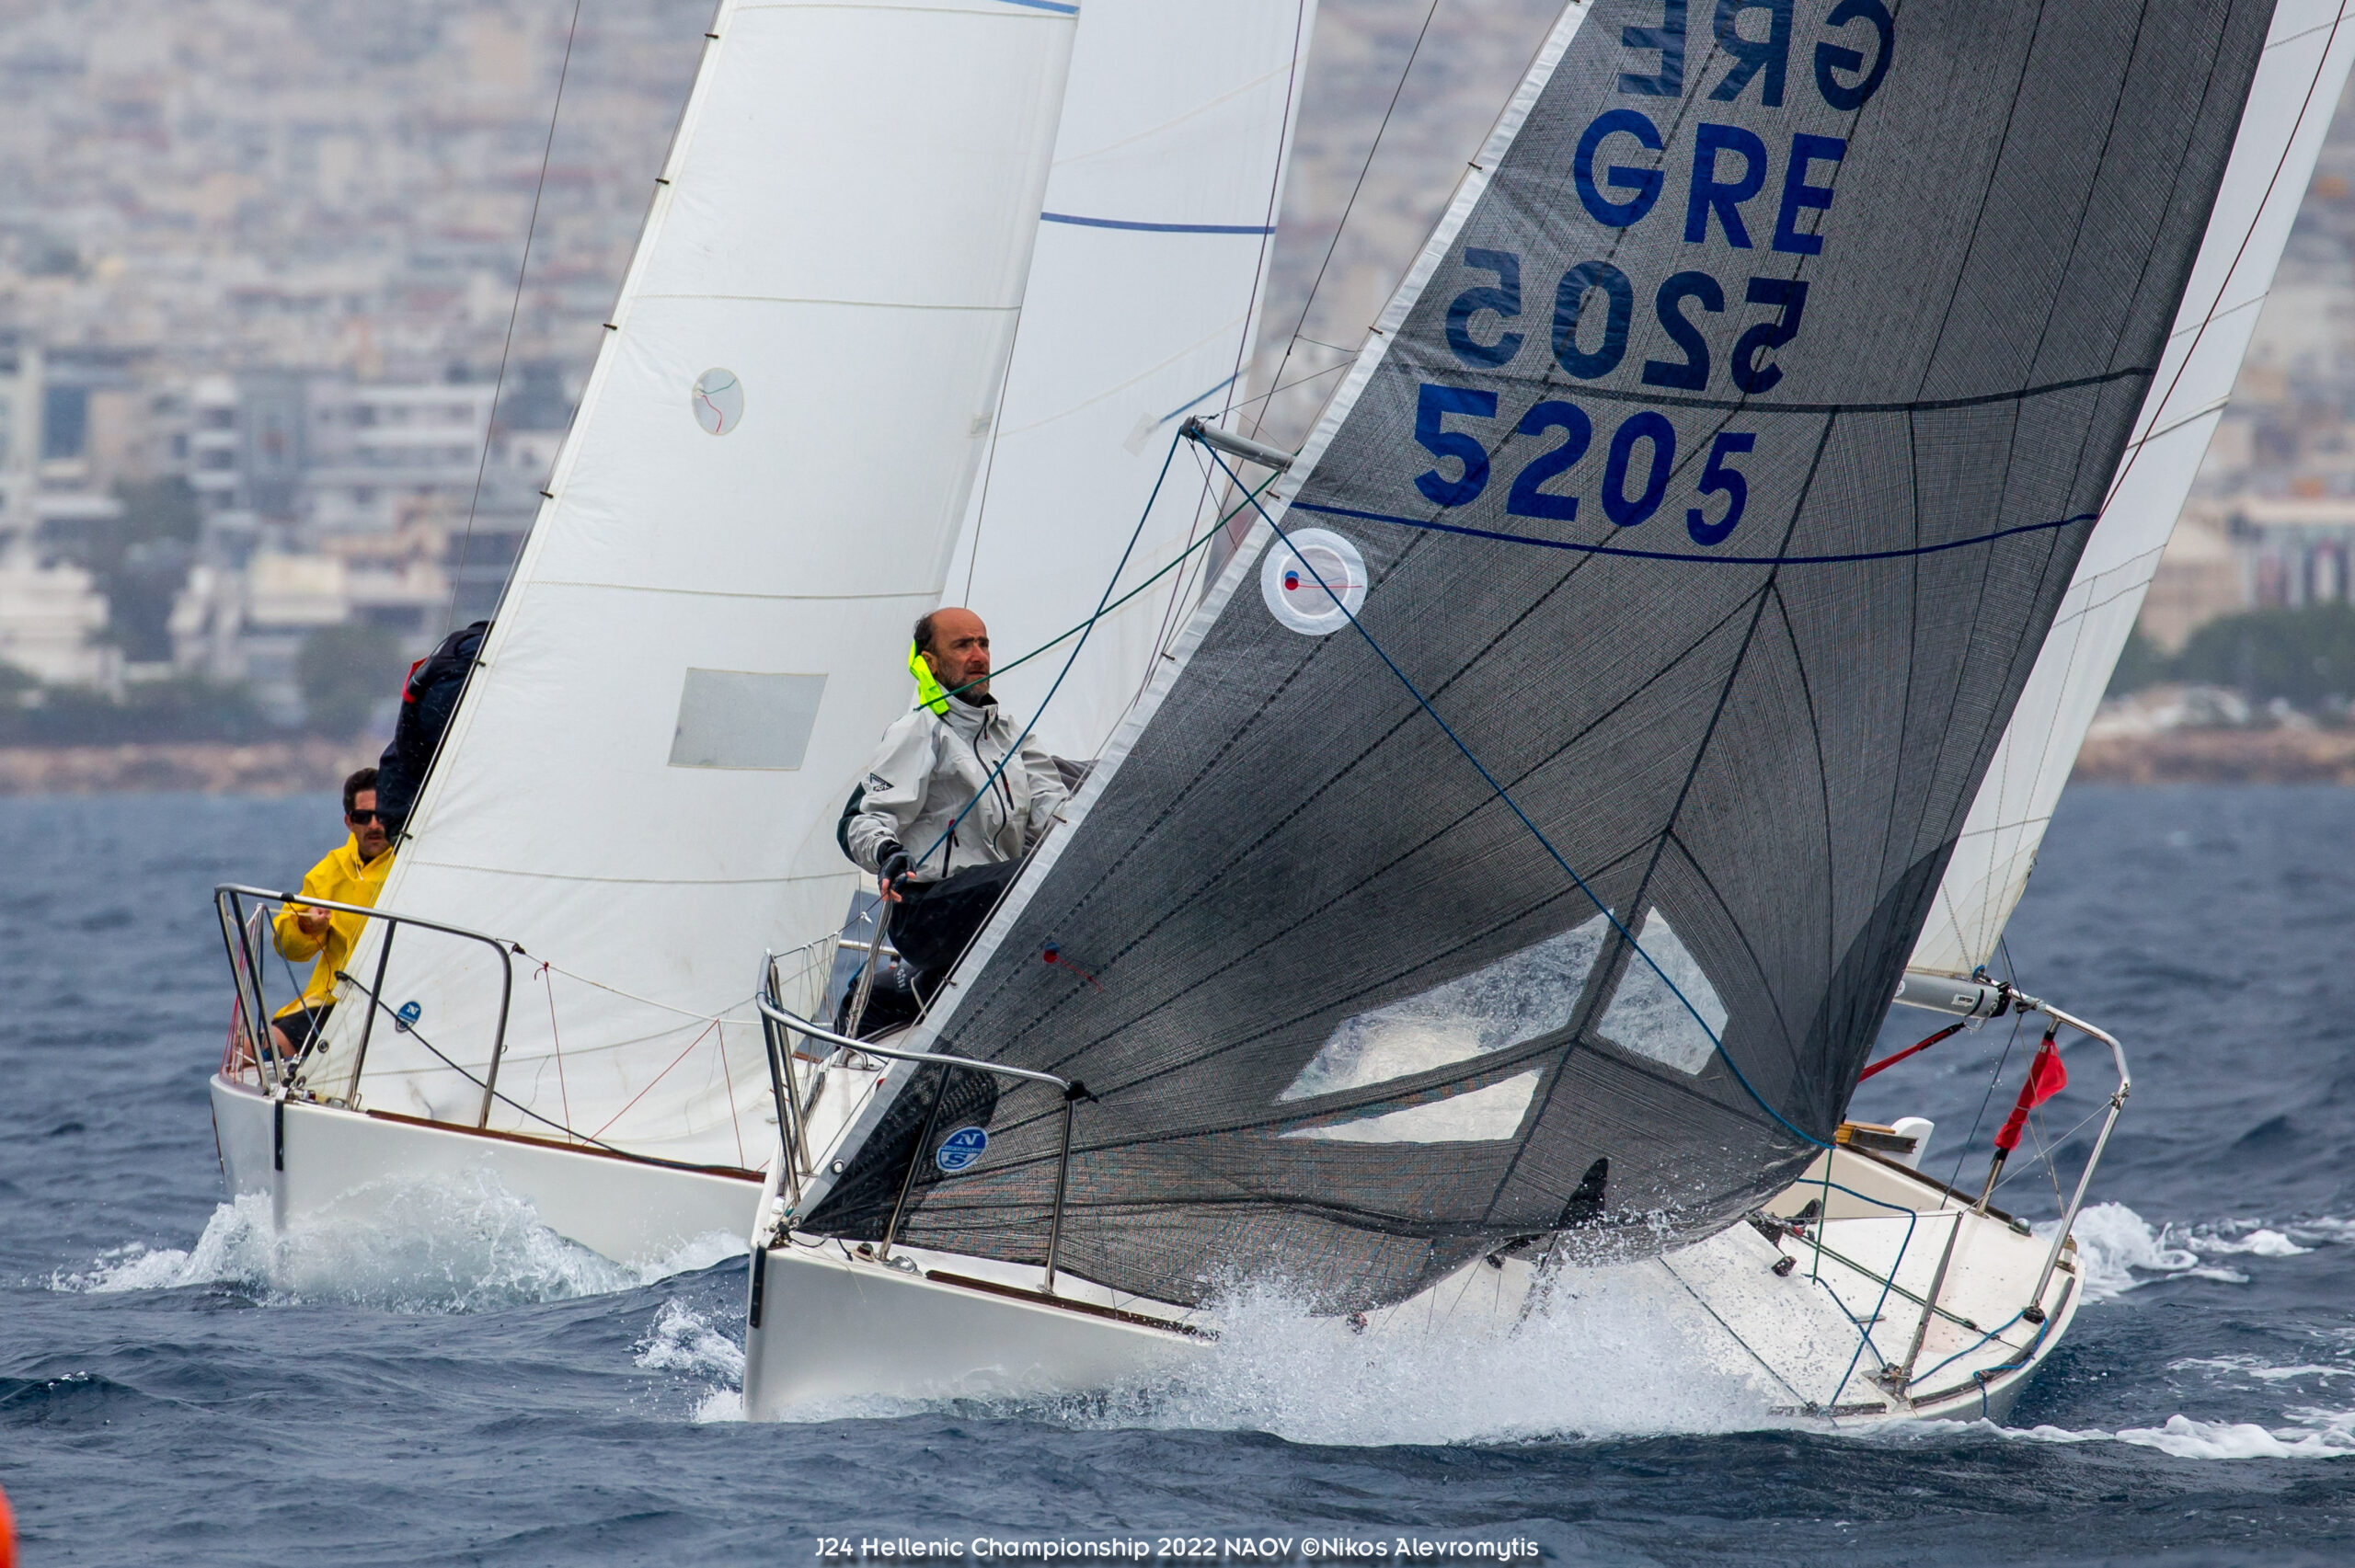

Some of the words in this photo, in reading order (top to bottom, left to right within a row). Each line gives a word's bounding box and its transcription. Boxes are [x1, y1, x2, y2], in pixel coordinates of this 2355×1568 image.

[1573, 109, 1847, 256] GRE
[1413, 383, 1756, 546] 5205
[945, 1153, 968, 1165] S
[955, 1133, 981, 1146] N
